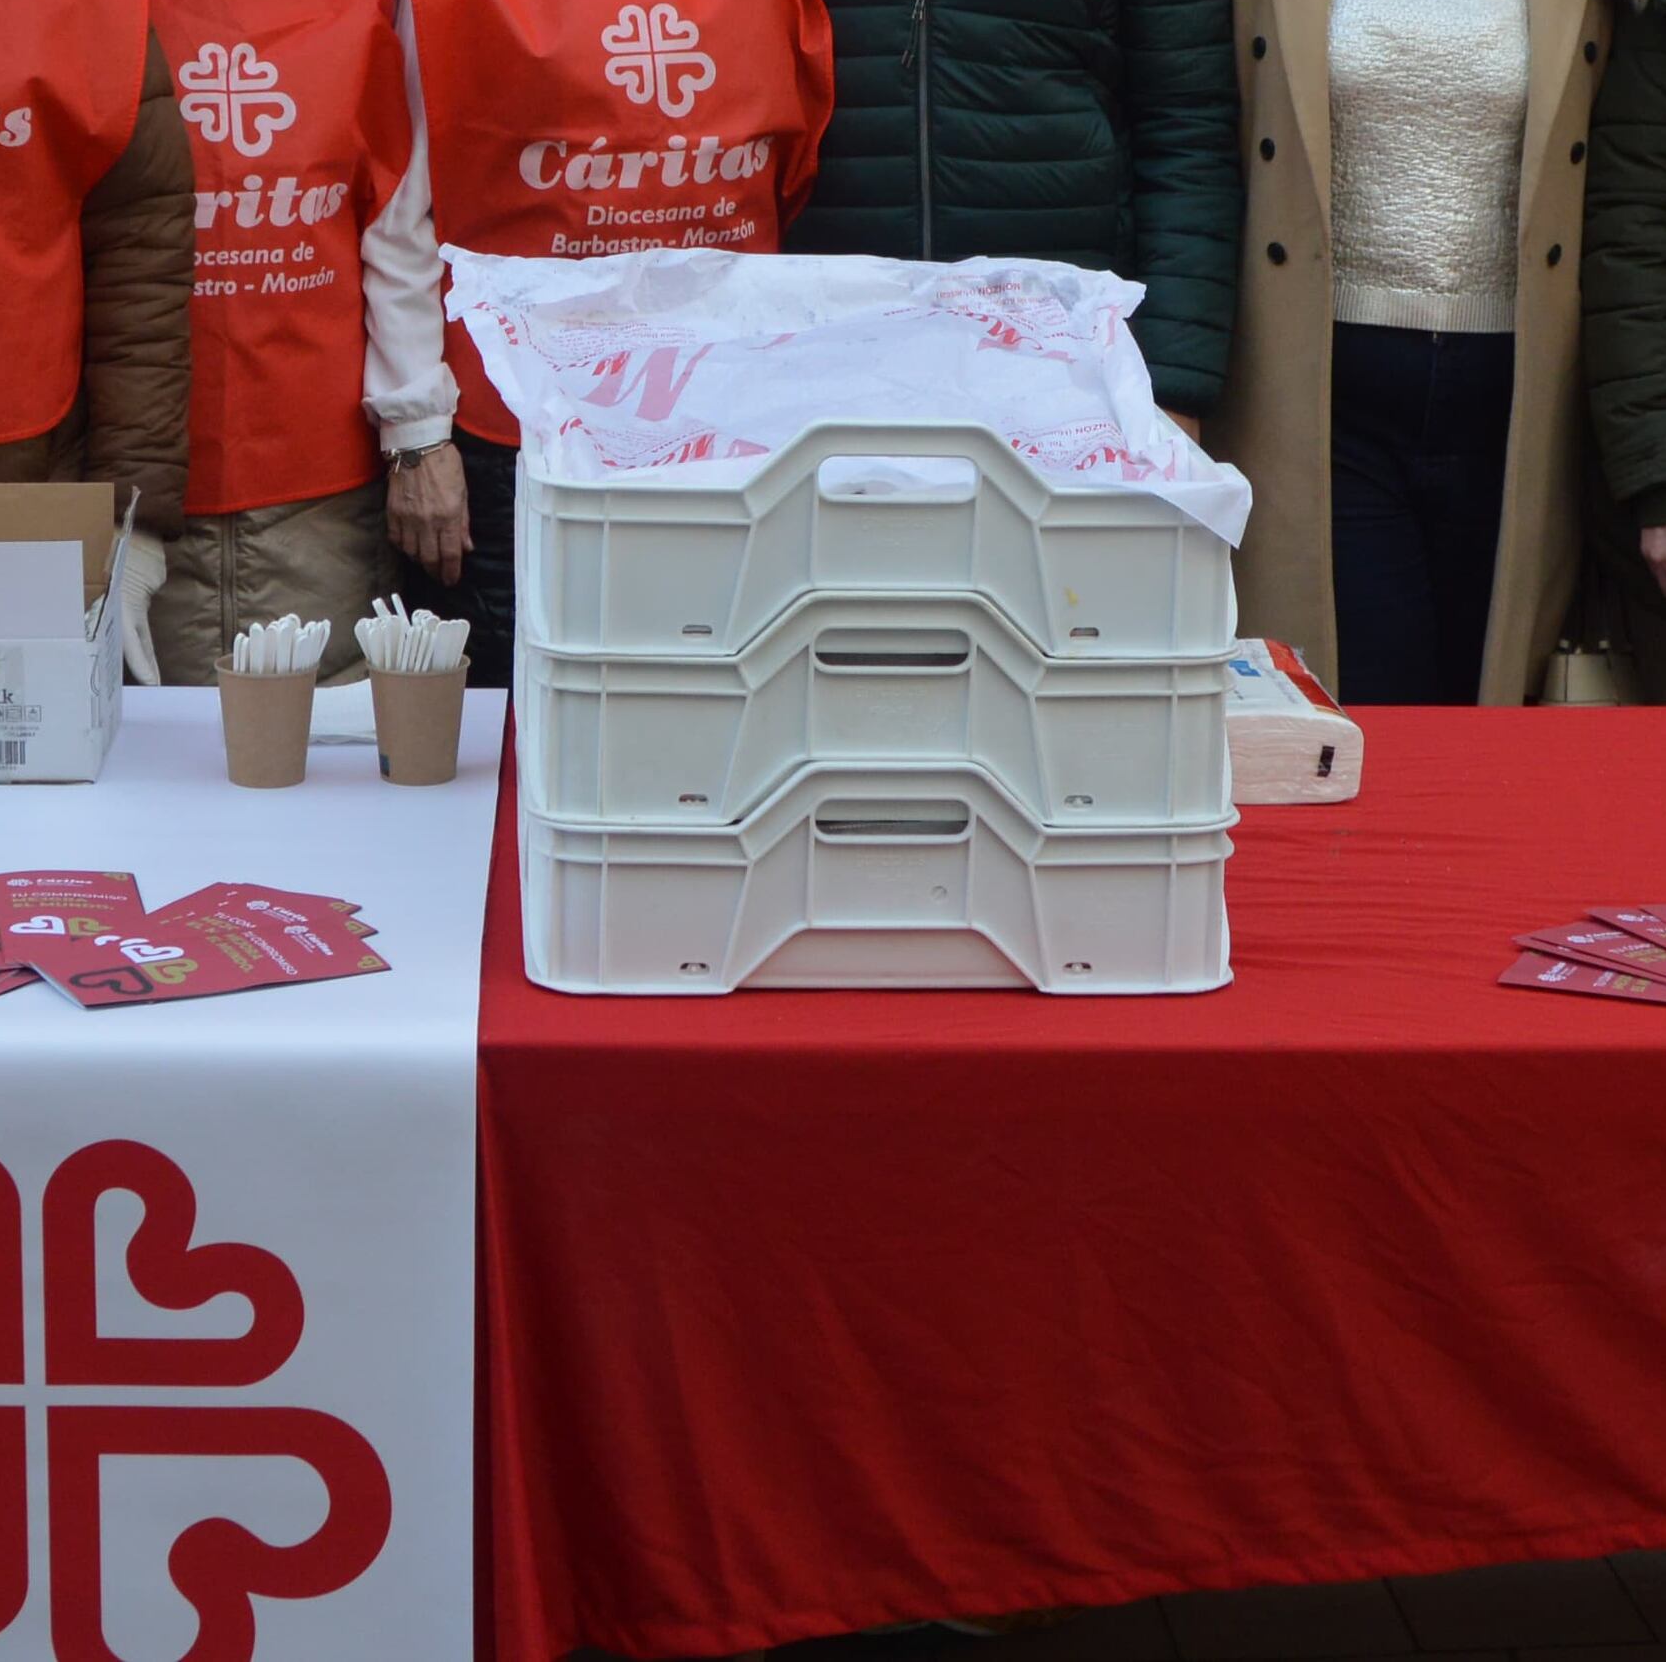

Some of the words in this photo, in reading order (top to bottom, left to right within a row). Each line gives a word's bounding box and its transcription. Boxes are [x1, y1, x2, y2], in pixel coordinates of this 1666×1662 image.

[518, 134, 775, 191] Cáritas
[586, 205, 706, 227] Diocesana
[712, 196, 737, 218] de
[292, 241, 315, 262] de
[550, 232, 663, 255] Barbastro
[682, 218, 755, 249] Monzón
[260, 266, 335, 295] Monzón
